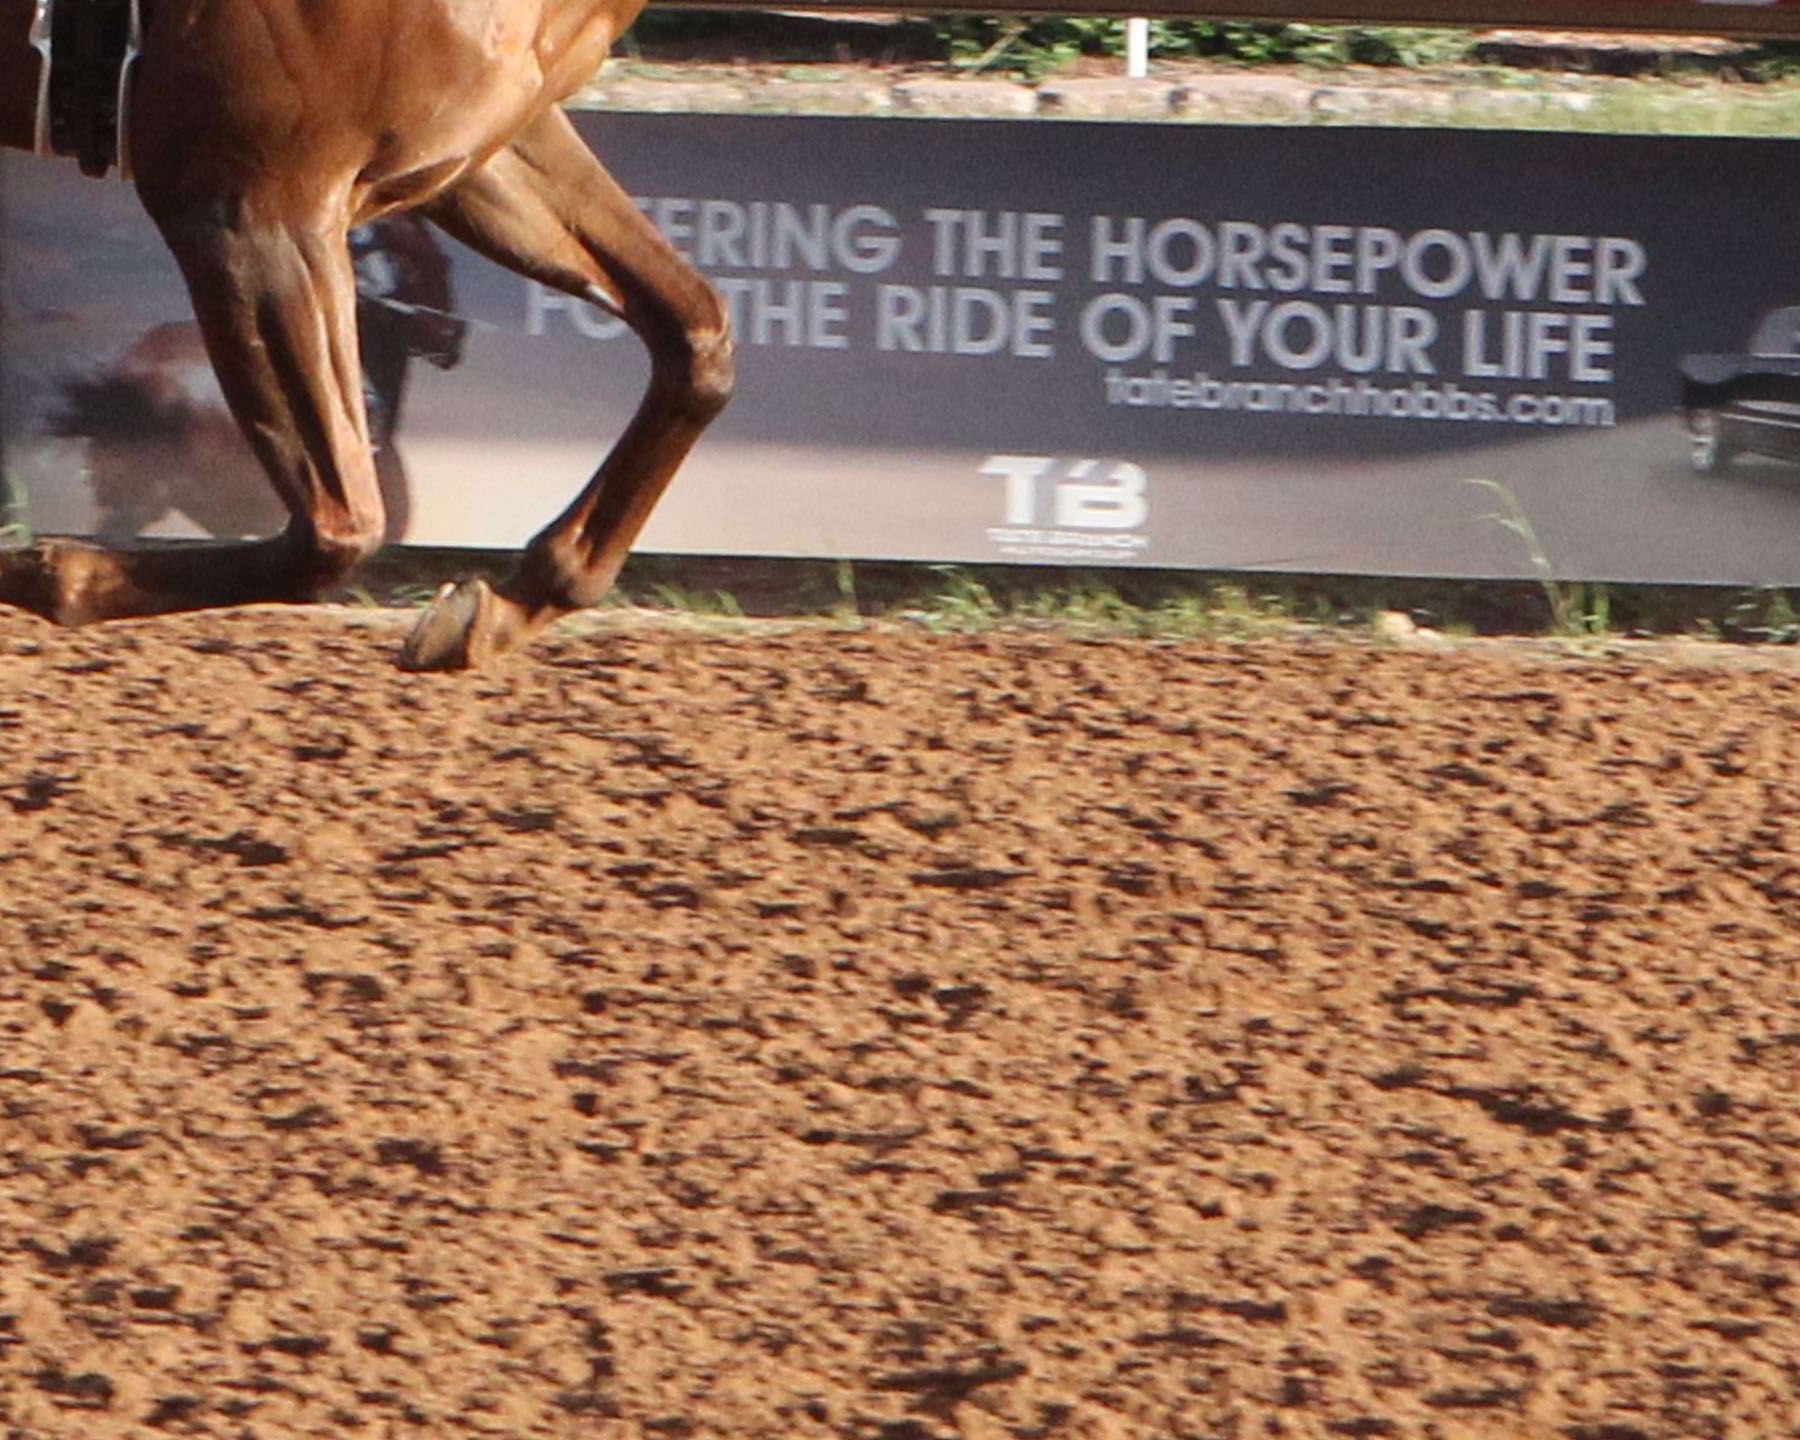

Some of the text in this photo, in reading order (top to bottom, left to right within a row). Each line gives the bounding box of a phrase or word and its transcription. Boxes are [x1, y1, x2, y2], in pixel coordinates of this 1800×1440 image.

[924, 208, 1065, 281] THE
[1090, 215, 1647, 307] HORSEPOWER
[712, 276, 850, 350] THE
[876, 284, 1057, 358] RIDE
[1080, 292, 1198, 362] OF
[1216, 298, 1442, 376] YOUR
[1462, 308, 1616, 384] LIFE
[1103, 366, 1618, 428] tatebranchhobbs.com
